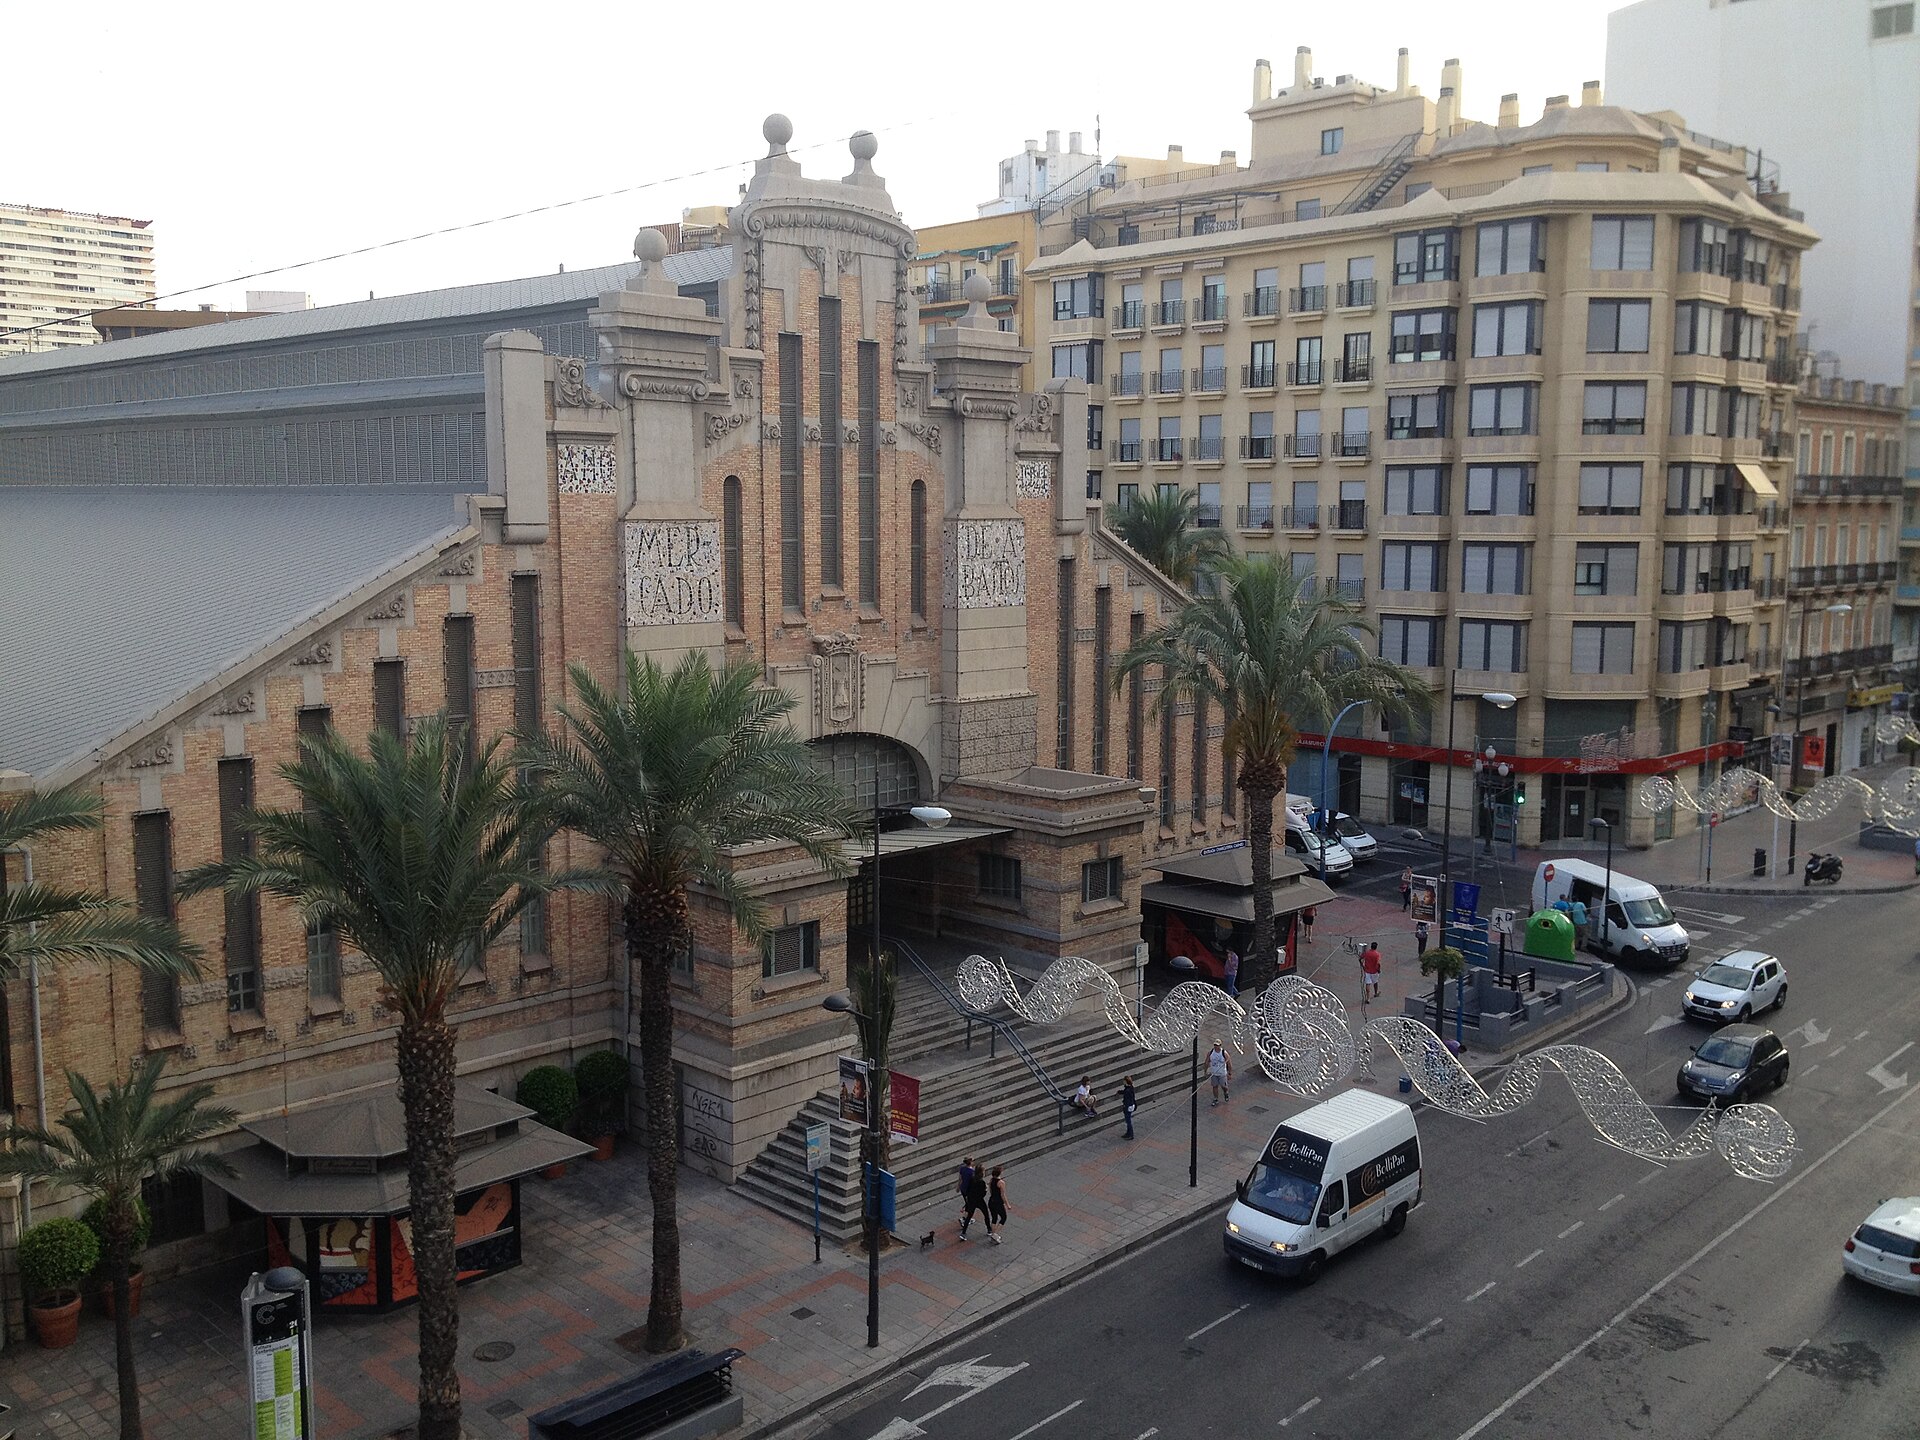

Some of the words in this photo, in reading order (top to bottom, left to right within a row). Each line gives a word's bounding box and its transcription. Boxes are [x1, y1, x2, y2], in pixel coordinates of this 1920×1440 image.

[965, 525, 993, 560] DE
[639, 575, 713, 617] CADO
[1289, 1142, 1323, 1163] BolliPan
[1375, 1154, 1406, 1178] BolliPan
